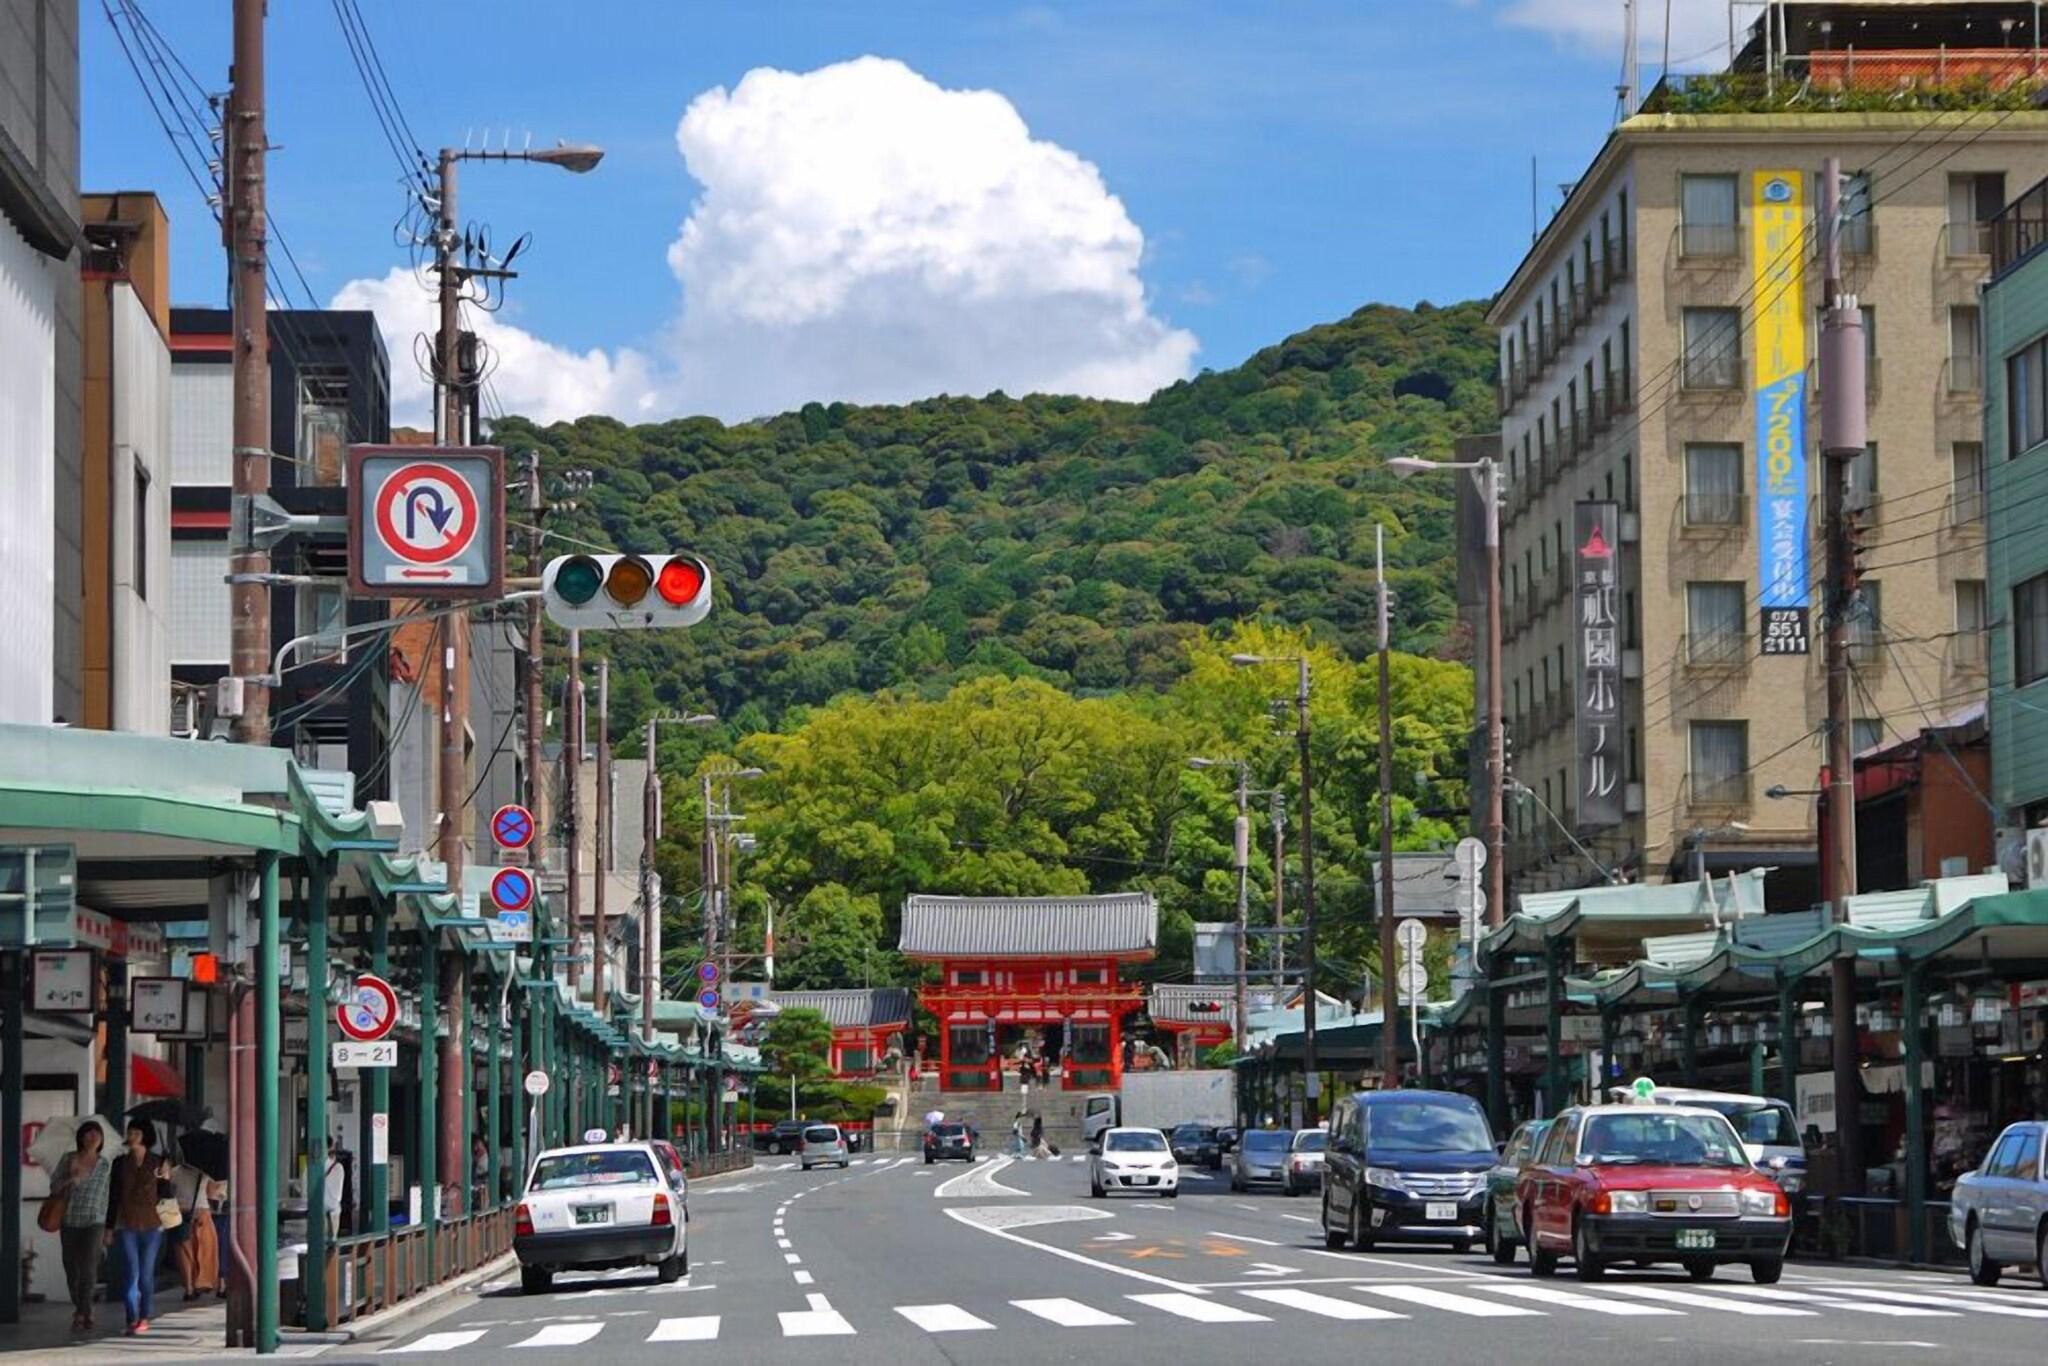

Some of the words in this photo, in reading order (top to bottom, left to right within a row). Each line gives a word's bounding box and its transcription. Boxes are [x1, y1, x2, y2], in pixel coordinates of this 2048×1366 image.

[1769, 622, 1801, 637] 551
[1764, 636, 1806, 652] 2111
[1583, 586, 1617, 797] 祇園ホテル
